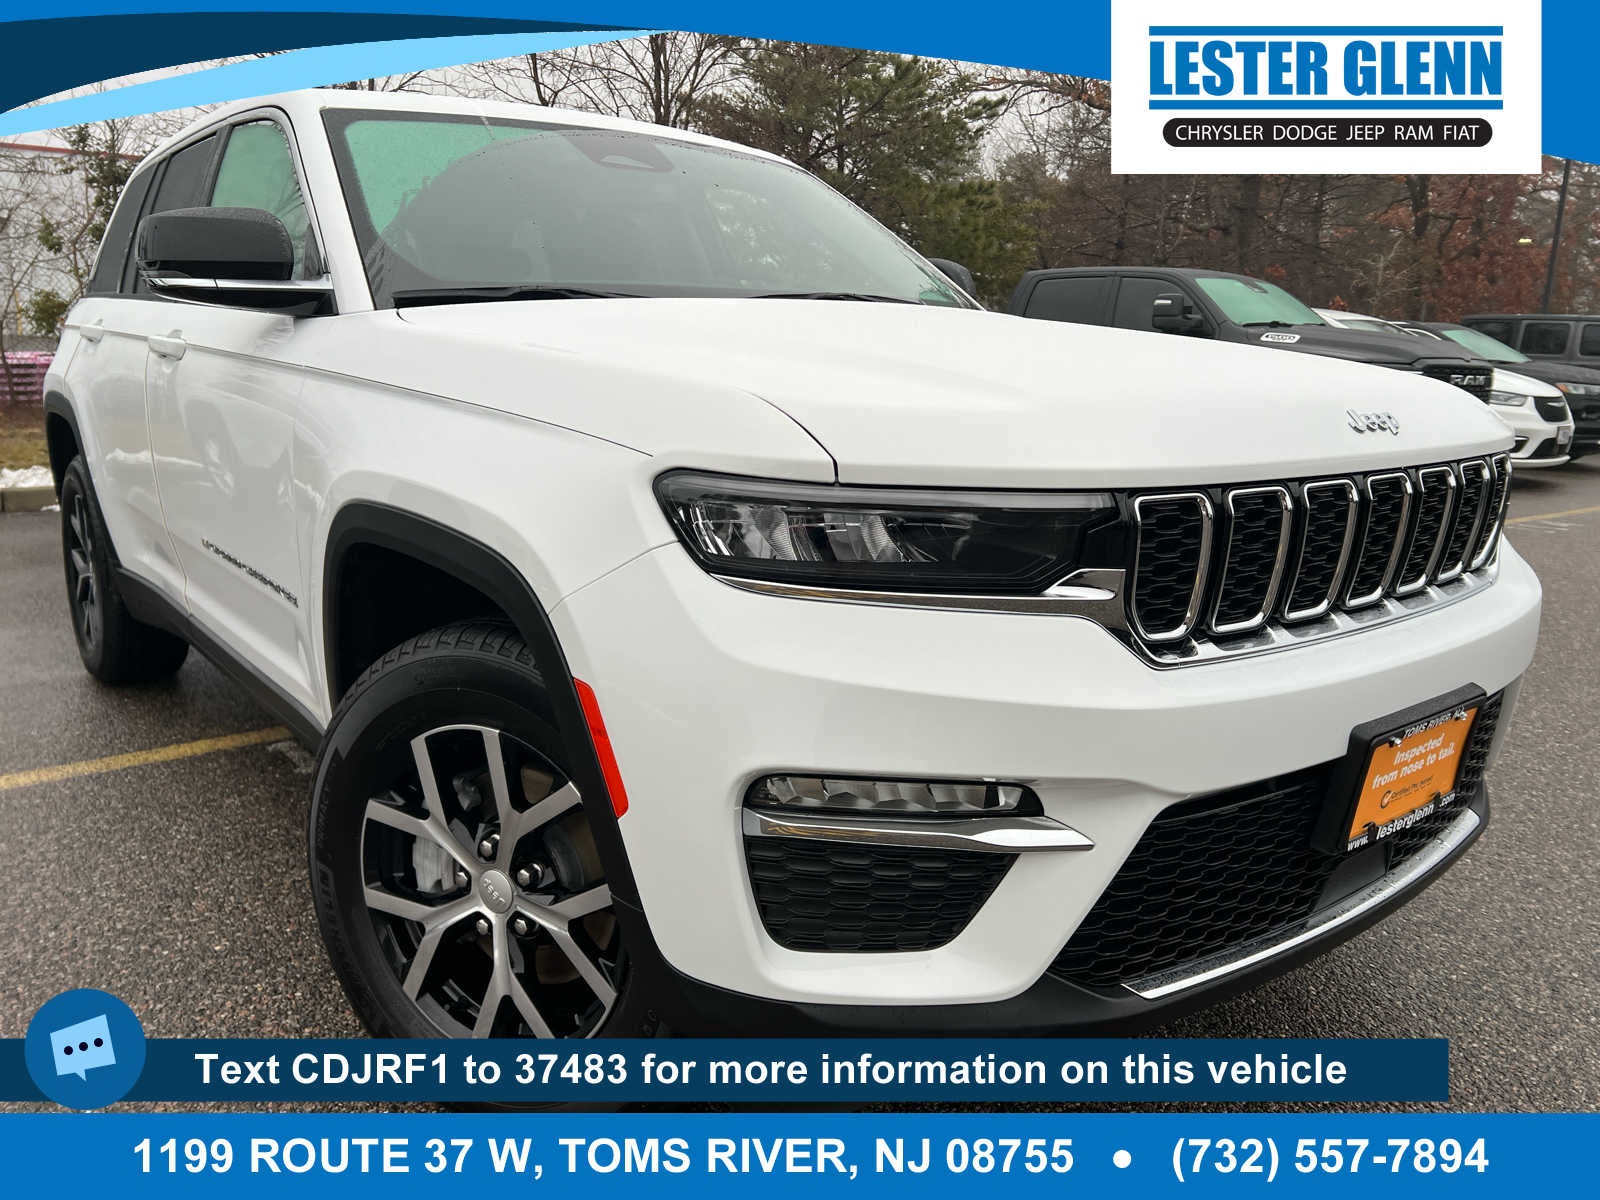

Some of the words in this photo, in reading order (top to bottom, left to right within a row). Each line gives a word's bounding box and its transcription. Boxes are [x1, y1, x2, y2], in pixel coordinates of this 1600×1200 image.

[1450, 374, 1488, 386] RAM
[1345, 409, 1400, 436] Jeep
[1403, 721, 1428, 740] TOMS
[1393, 732, 1446, 766] Inspected
[1371, 769, 1399, 790] from
[1399, 758, 1425, 779] nose
[1426, 752, 1438, 767] to
[1375, 803, 1435, 841] lesterglenn
[1439, 792, 1457, 808] .com
